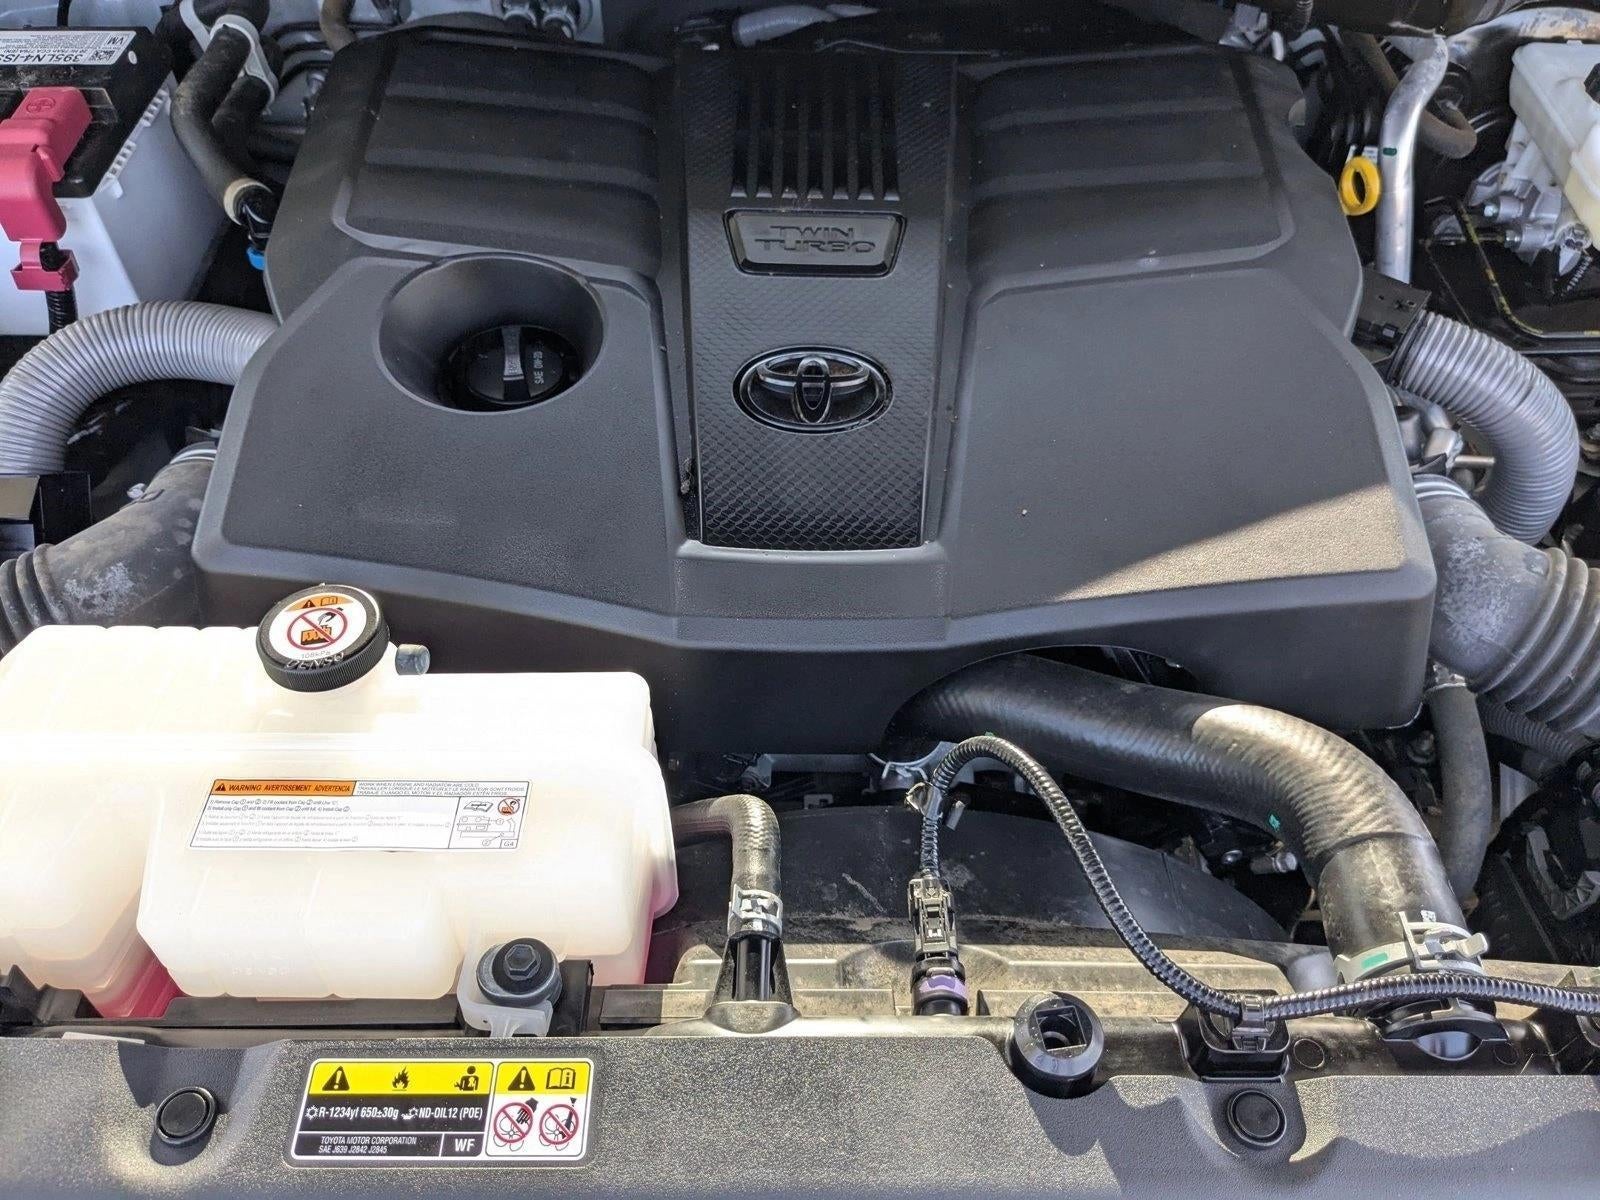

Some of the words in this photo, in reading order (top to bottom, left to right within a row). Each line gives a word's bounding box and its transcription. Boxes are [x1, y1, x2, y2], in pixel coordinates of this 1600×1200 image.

[107, 37, 124, 45] VM
[769, 226, 854, 240] TWIN
[754, 238, 876, 253] TURBO
[533, 371, 545, 384] SAE
[286, 652, 344, 670] DENSO
[228, 784, 262, 792] WARNING
[264, 784, 312, 792] AVERTISSEMENT
[313, 784, 350, 792] ADVERTENCIA
[318, 1106, 359, 1120] R-1234yf
[361, 1106, 399, 1120] 650±30g
[419, 1106, 458, 1120] ND-OIL12
[460, 1106, 483, 1120] (POE)
[320, 1136, 345, 1144] TOYOTA
[346, 1136, 370, 1144] MOTOR
[371, 1136, 417, 1144] CORPORATION
[454, 1138, 475, 1152] WF
[318, 1146, 331, 1154] SAE
[332, 1146, 348, 1154] J639
[348, 1146, 367, 1154] J2842
[368, 1146, 388, 1154] J2845
